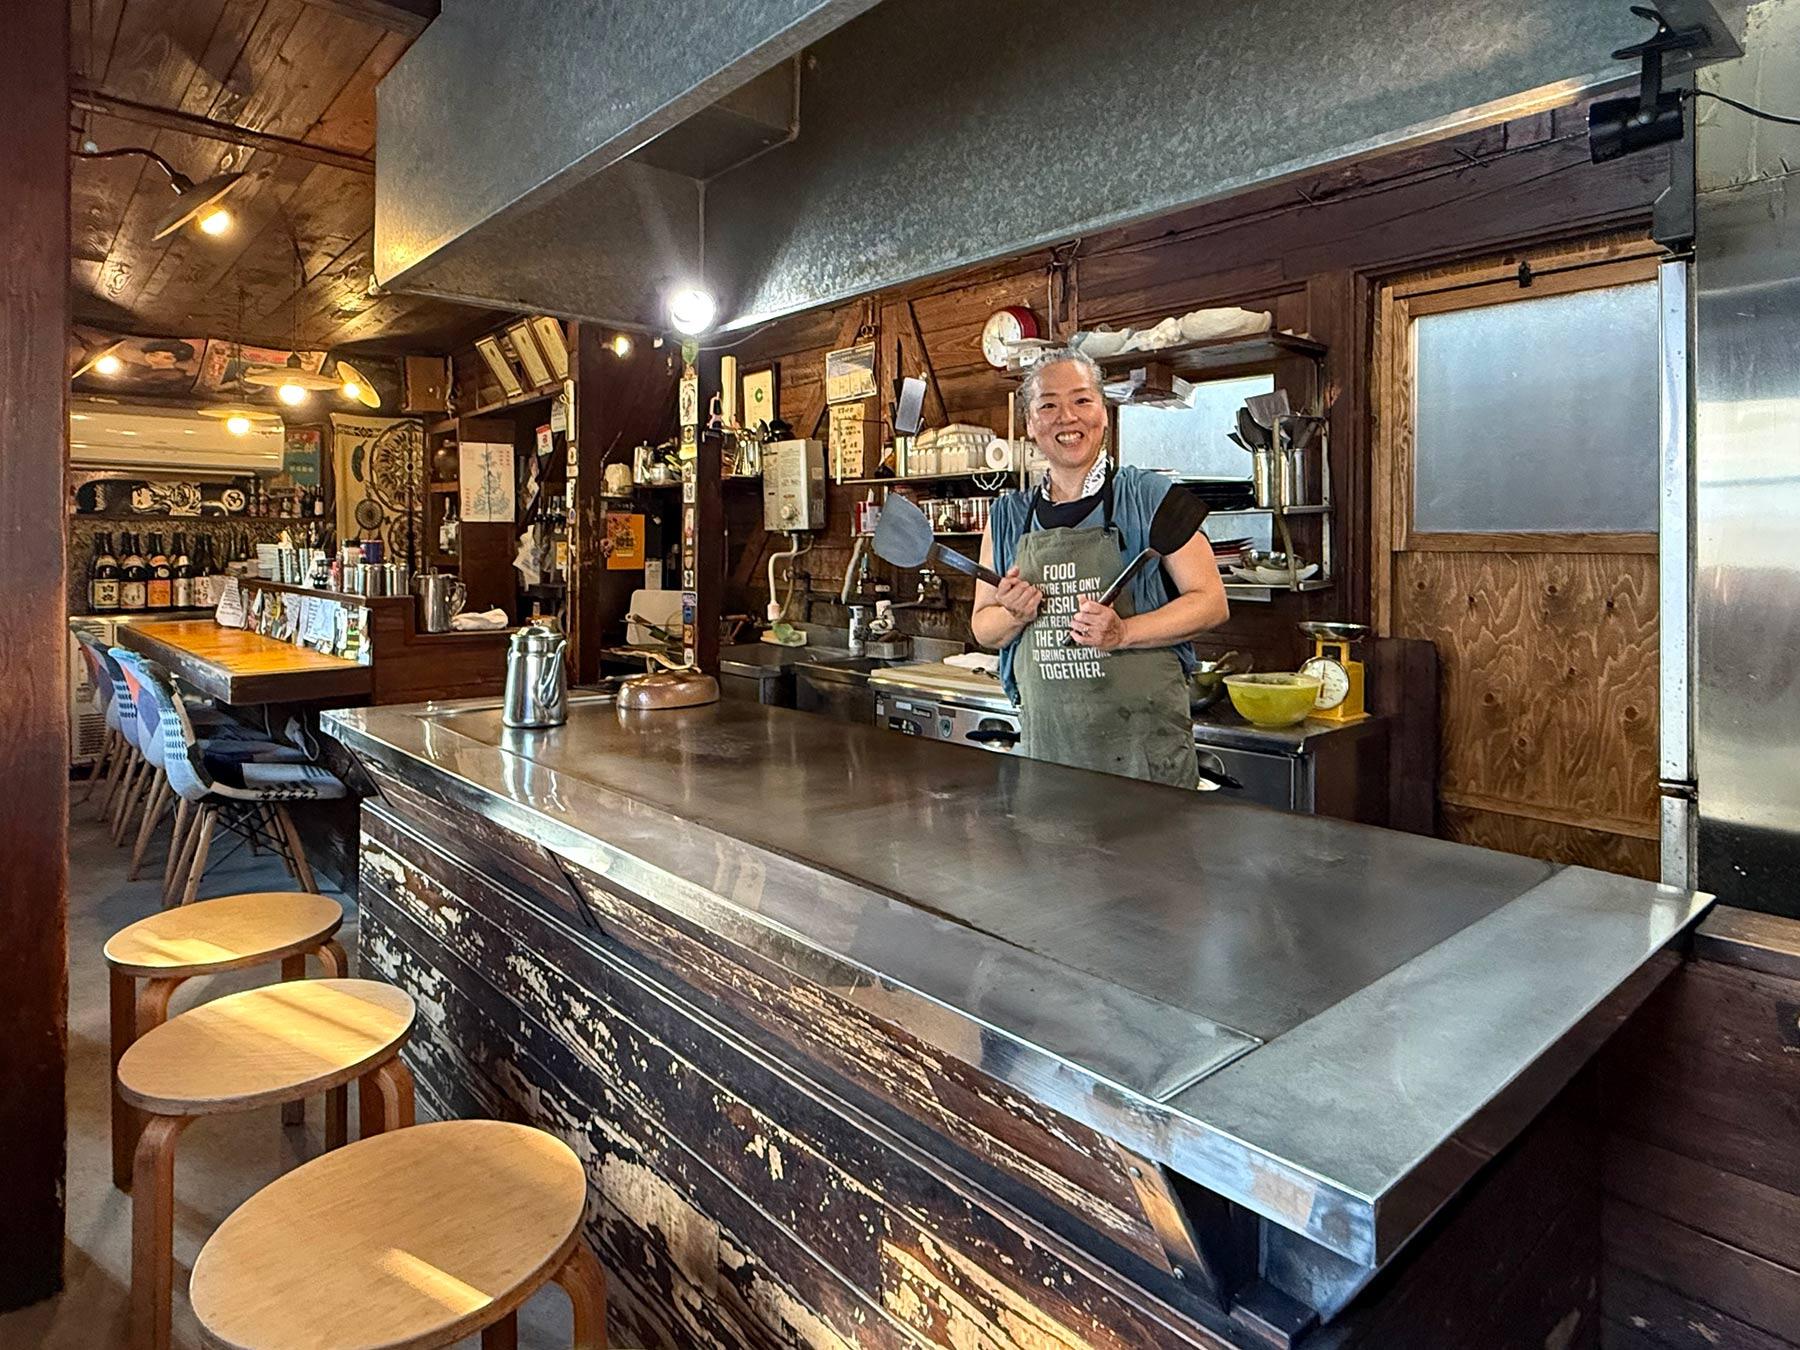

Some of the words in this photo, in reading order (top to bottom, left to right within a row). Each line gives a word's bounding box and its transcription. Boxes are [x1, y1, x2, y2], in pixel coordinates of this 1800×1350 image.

[1043, 562, 1076, 581] FOOD
[1061, 581, 1078, 594] THE
[1079, 576, 1101, 591] ONLY
[1041, 595, 1078, 614] ERSAL
[1050, 615, 1073, 628] REAL
[1035, 629, 1054, 648] THE
[1041, 649, 1065, 662] BRING
[1066, 647, 1112, 661] EVERYO
[1039, 661, 1106, 681] TOGETHER.
